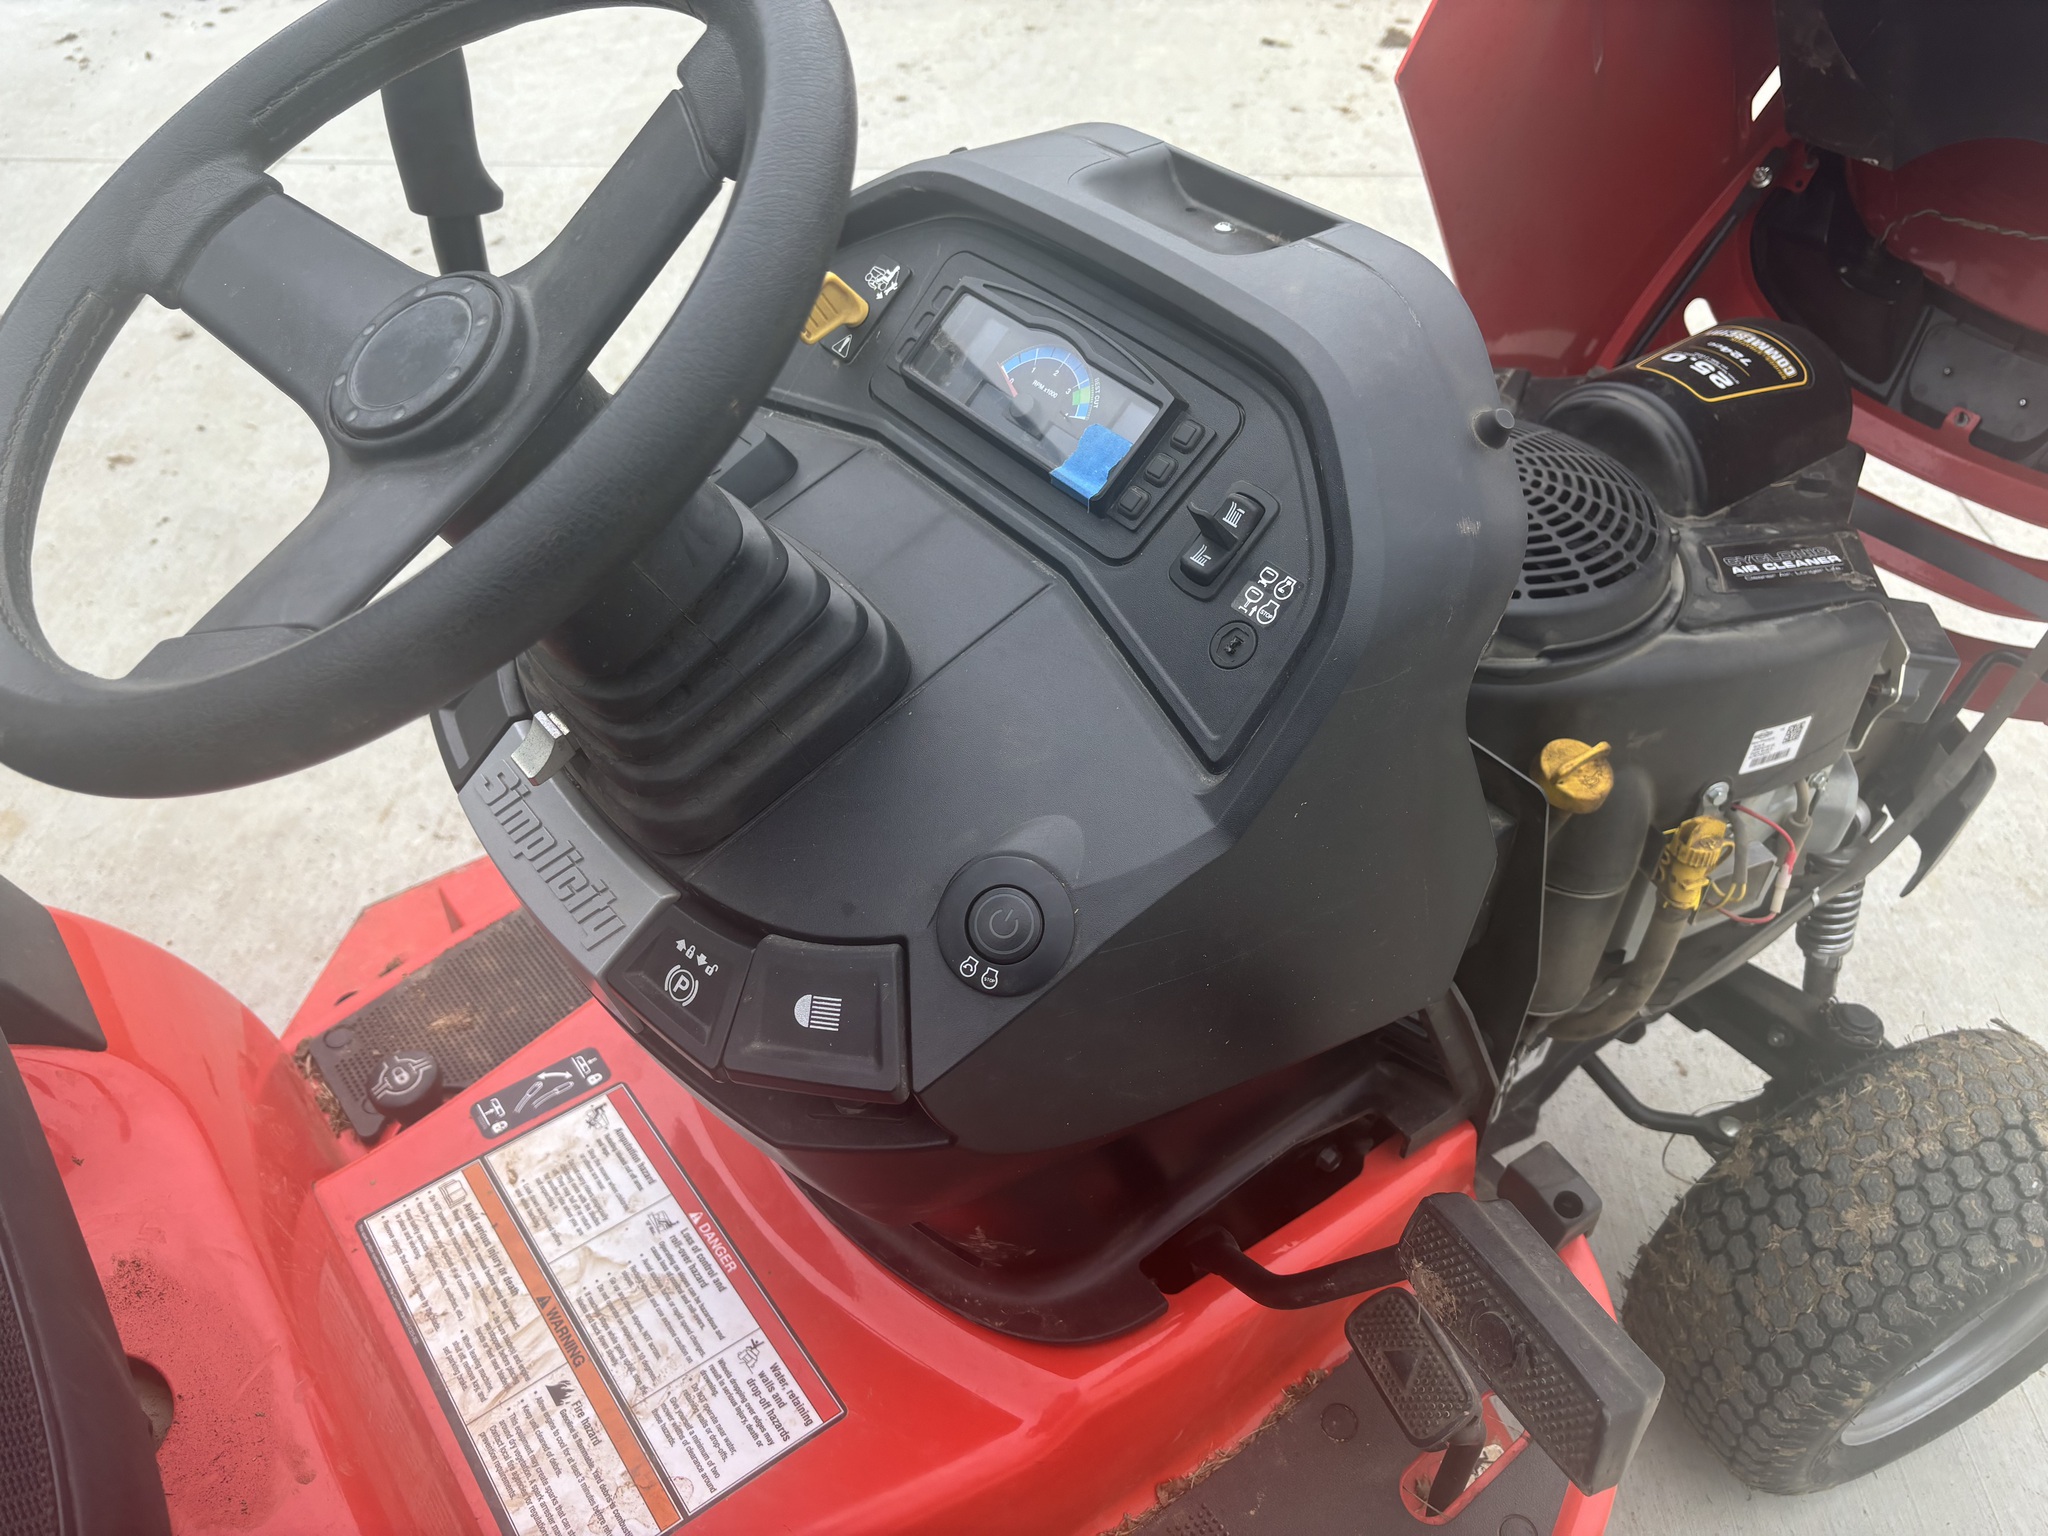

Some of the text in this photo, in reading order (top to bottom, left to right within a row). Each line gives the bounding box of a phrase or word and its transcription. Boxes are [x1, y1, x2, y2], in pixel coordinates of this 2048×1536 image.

[1031, 379, 1045, 392] RPM
[1661, 352, 1734, 389] 25.0
[1722, 546, 1831, 567] CYCLONIC
[1732, 554, 1842, 575] AIR CLEANER
[1259, 608, 1273, 619] STOP
[474, 758, 627, 951] Simplicity
[672, 974, 690, 992] P
[613, 1126, 642, 1163] Amputation
[636, 1161, 657, 1185] hazard
[462, 1201, 519, 1297] Avoid serious injury or death
[669, 1234, 708, 1288] roll-over hazard
[680, 1227, 727, 1292] Loss of control and
[698, 1222, 737, 1272] DANGER
[545, 1307, 586, 1367] WARNING
[698, 1369, 720, 1397] drowning.
[757, 1369, 786, 1408] walls and
[767, 1362, 814, 1426] Water, retaining
[534, 1395, 547, 1412] Allow
[668, 1396, 680, 1410] Give
[707, 1364, 763, 1448] result in serious injury, death or
[715, 1358, 775, 1446] Wheels dropping over edges may
[744, 1377, 791, 1442] drop-off hazards
[498, 1418, 513, 1439] around
[542, 1410, 557, 1430] engine
[551, 1429, 560, 1437] to
[571, 1400, 601, 1446] Fire hazard
[651, 1408, 676, 1446] these hazards.
[675, 1408, 692, 1431] yourself
[690, 1383, 737, 1455] Do NOT operate near water,
[508, 1438, 518, 1449] dry
[521, 1404, 533, 1419] Keep
[528, 1418, 539, 1431] unit
[534, 1429, 549, 1452] cleaned
[548, 1457, 563, 1478] debris.
[555, 1435, 566, 1449] cool
[660, 1402, 674, 1421] mower
[670, 1420, 685, 1440] widths
[685, 1445, 704, 1473] clearance
[701, 1472, 716, 1493] around
[690, 1434, 710, 1461] minimum
[695, 1412, 708, 1428] walls
[704, 1427, 712, 1435] or
[708, 1433, 729, 1462] drop-offs.
[479, 1431, 516, 1500] prevention requirements.
[489, 1425, 504, 1447] Contact
[499, 1446, 511, 1461] local
[506, 1459, 516, 1471] fire
[523, 1496, 533, 1506] for
[512, 1447, 533, 1480] vegetation.
[559, 1408, 576, 1433] Gasoline
[575, 1438, 596, 1470] flammable.
[591, 1469, 603, 1484] Yard
[598, 1483, 613, 1502] debris
[608, 1501, 616, 1509] is
[561, 1447, 571, 1458] for
[566, 1456, 574, 1464] at
[705, 1459, 714, 1468] of
[508, 1413, 519, 1426] This
[514, 1424, 534, 1455] equipment
[528, 1453, 540, 1467] may
[535, 1466, 549, 1486] create
[544, 1484, 559, 1506] sparks
[554, 1504, 565, 1518] that
[560, 1517, 571, 1530] can
[569, 1462, 582, 1478] least
[709, 1466, 721, 1479] two
[530, 1483, 544, 1502] spark
[579, 1481, 596, 1506] minutes
[538, 1500, 555, 1525] arrester
[591, 1505, 606, 1526] before
